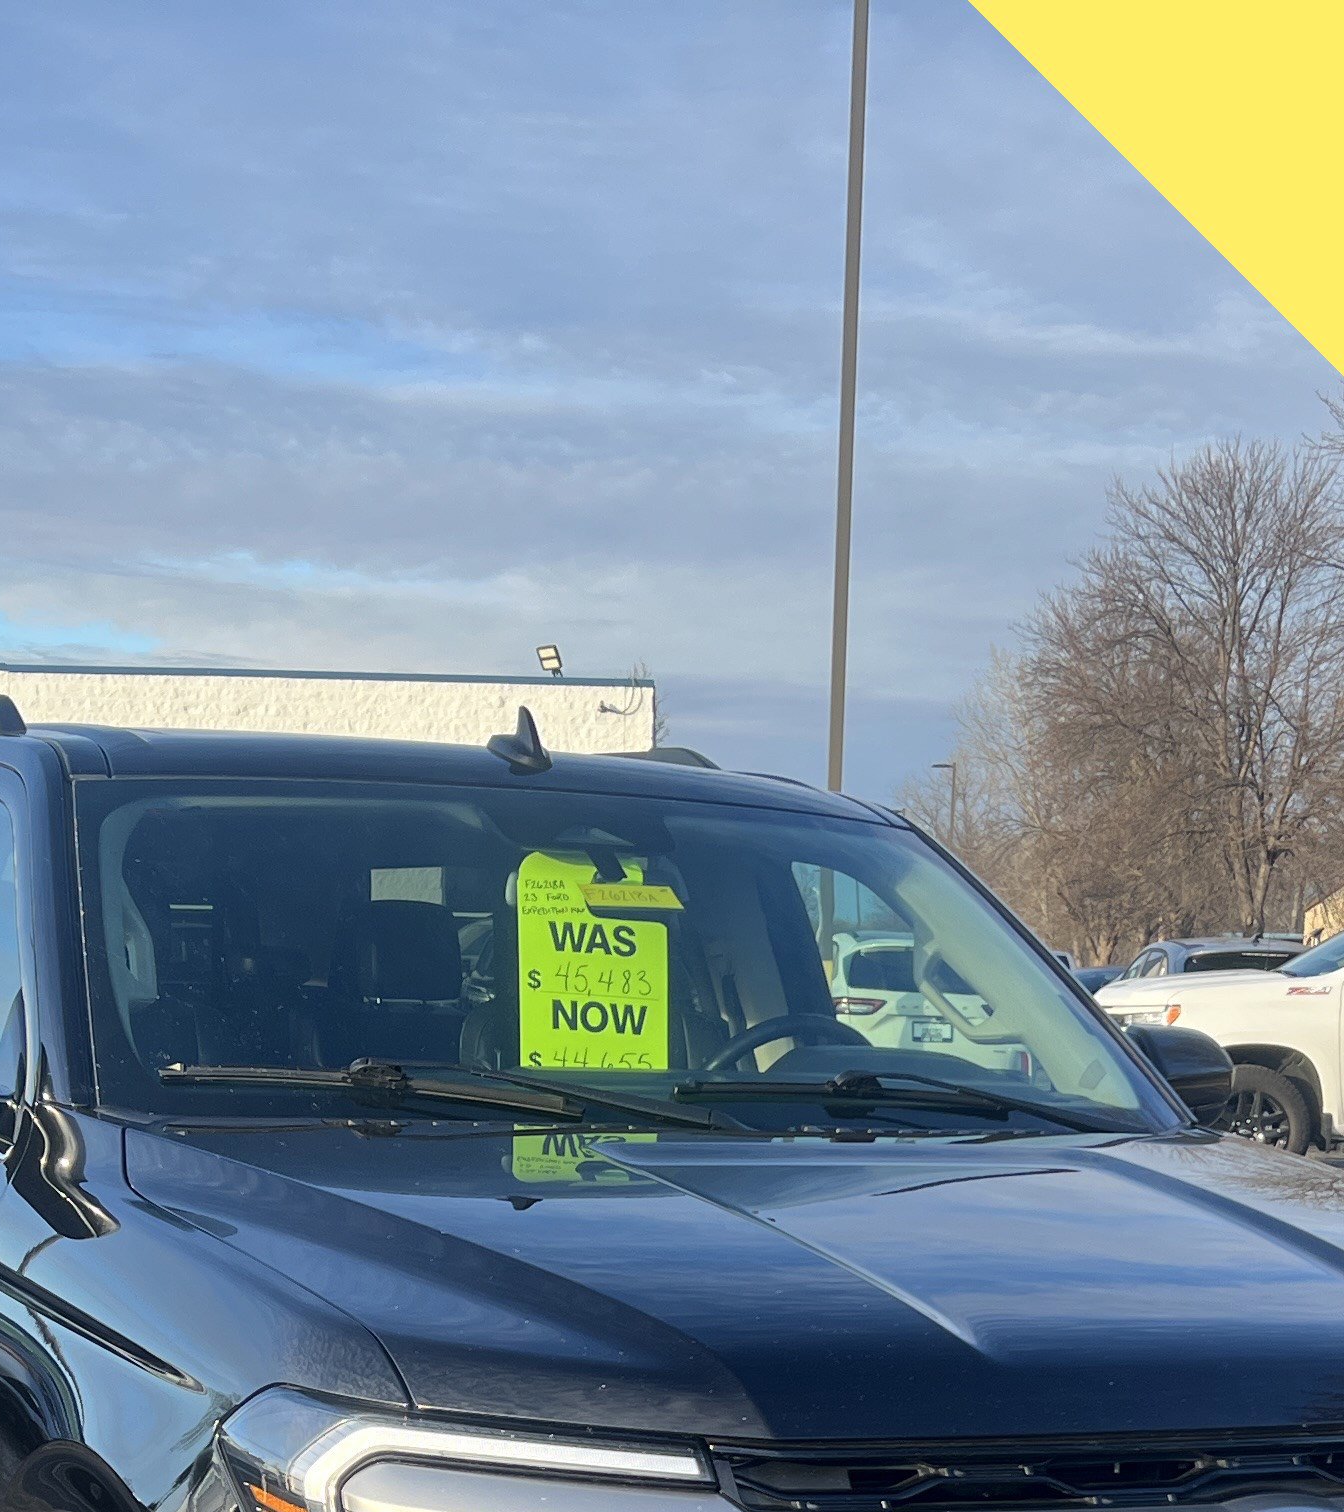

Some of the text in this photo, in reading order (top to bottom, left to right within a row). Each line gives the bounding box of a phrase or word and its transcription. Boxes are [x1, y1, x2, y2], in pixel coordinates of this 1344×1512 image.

[548, 920, 637, 958] WAS
[527, 960, 652, 997] $ 45,483
[551, 998, 648, 1036] NOW
[528, 1050, 542, 1068] $
